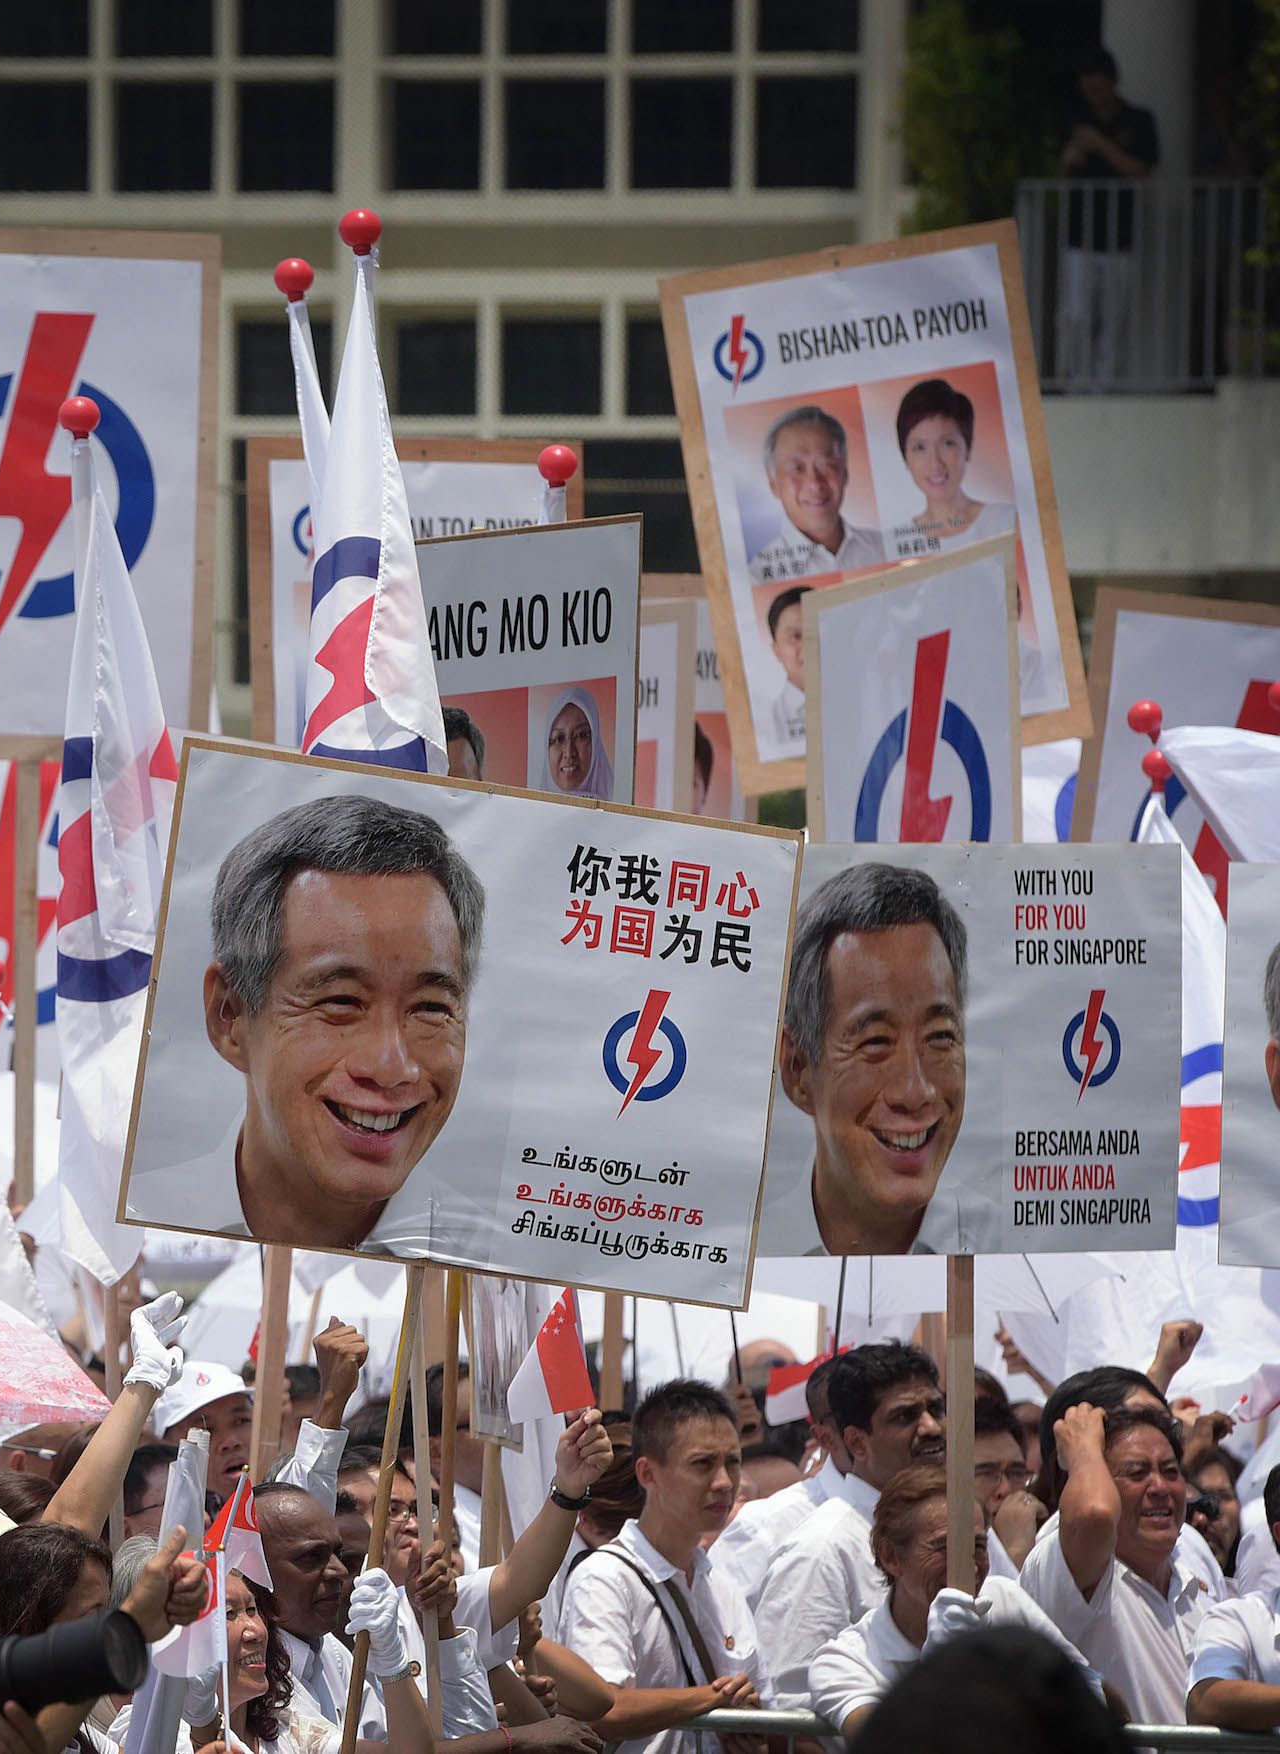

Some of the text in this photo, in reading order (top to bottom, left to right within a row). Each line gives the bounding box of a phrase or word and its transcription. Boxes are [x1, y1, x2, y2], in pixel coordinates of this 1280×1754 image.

[777, 298, 988, 364] BISHAN-TOA PAYOH
[428, 587, 612, 660] ANG MO KIO
[567, 844, 760, 918] 你我同心
[1014, 870, 1093, 895] WITH YOU
[560, 899, 752, 973] 为国为民
[1015, 904, 1085, 930] FOR YOU
[1015, 939, 1147, 965] FOR SINGAPORE
[1015, 1130, 1140, 1156] BERSAMA ANDA
[521, 1146, 690, 1186] உங்களுடன்
[1014, 1164, 1115, 1191] UNTUK ANDA
[516, 1182, 704, 1226] உங்களுக்காக
[1014, 1198, 1151, 1226] DEMI SINGAPURA
[511, 1210, 728, 1264] சிங்கப்பூருக்காக
